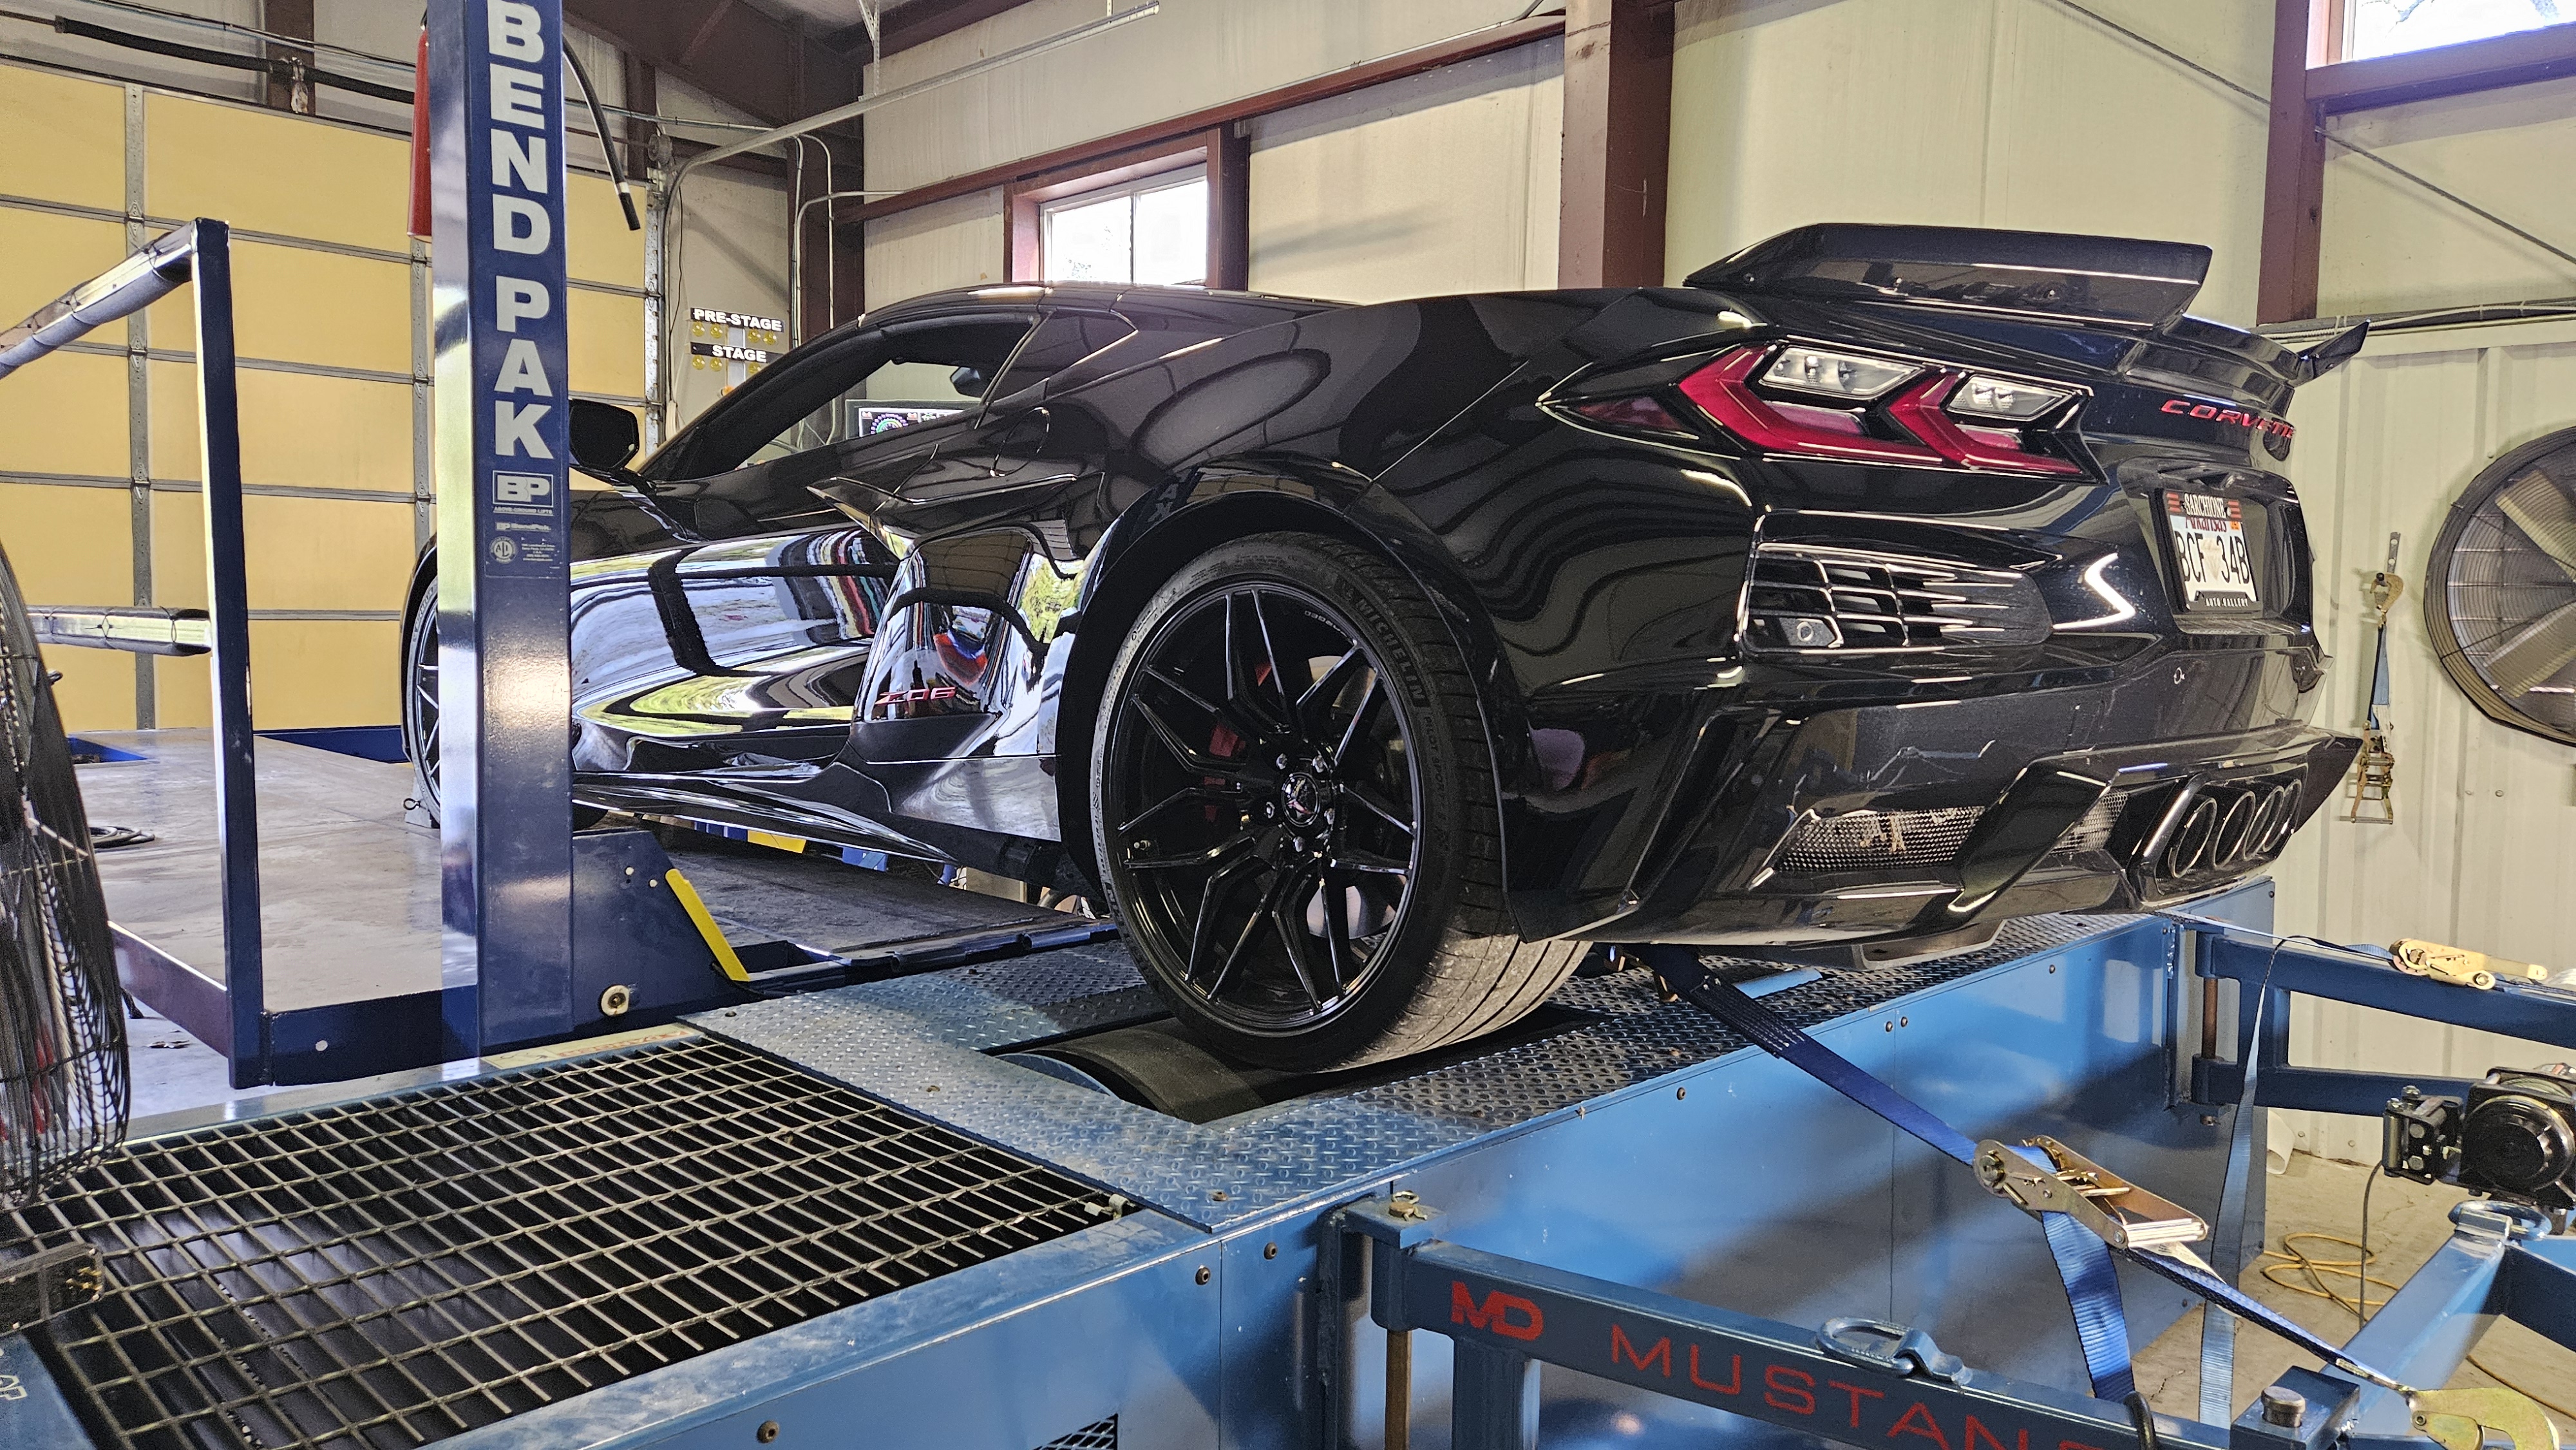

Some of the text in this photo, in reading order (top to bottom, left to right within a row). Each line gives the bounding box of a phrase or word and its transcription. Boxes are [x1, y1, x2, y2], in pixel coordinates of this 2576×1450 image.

[487, 0, 553, 459] BEND PAK
[693, 308, 782, 332] PRE-STAGE
[712, 344, 766, 362] STAGE
[2161, 399, 2295, 439] CORVETTE
[497, 475, 550, 502] BP
[2184, 493, 2226, 519] SARCHIONE
[2186, 516, 2227, 532] Arkansas
[2174, 531, 2249, 585] BCF 34B
[1355, 598, 1426, 701] MICHELIN
[875, 686, 957, 705] Z06
[1451, 1281, 2103, 1450] MD MUSTAN
